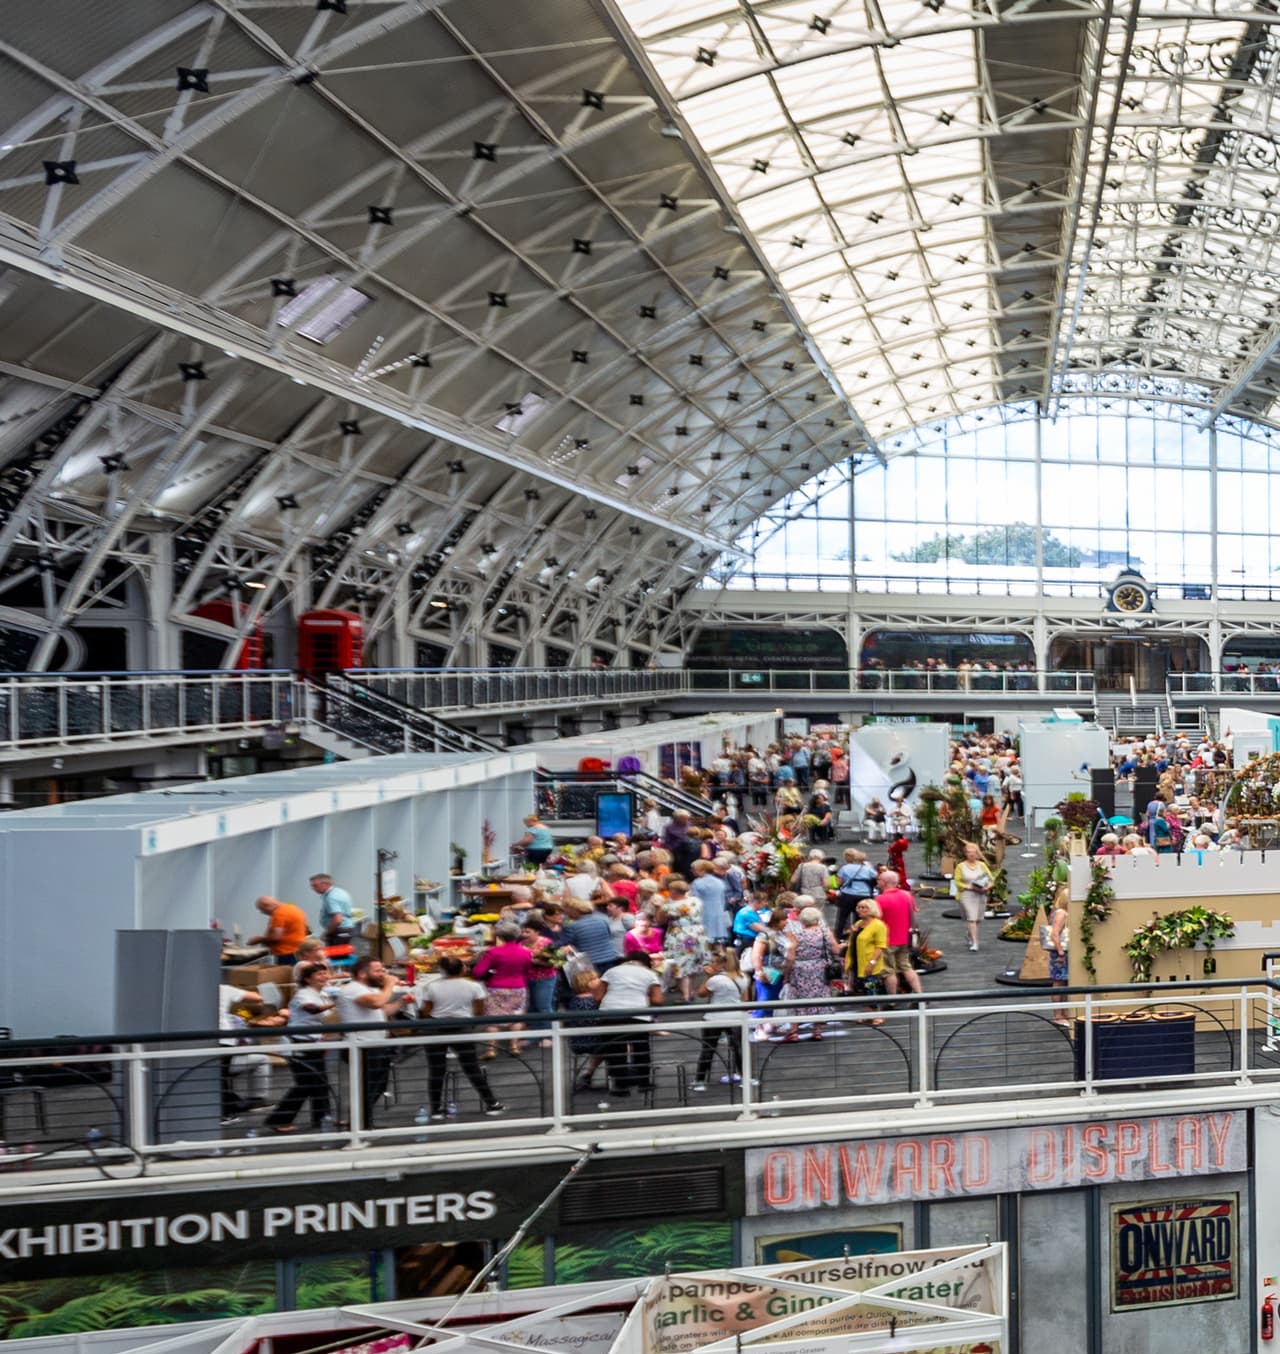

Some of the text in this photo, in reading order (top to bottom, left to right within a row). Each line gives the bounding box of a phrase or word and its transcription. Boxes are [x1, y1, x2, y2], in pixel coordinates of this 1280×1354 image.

[764, 1112, 1234, 1205] ONWARD DISPLAY
[263, 1190, 497, 1238] PRINTERS
[1119, 1216, 1232, 1274] ONWARD
[736, 1302, 755, 1322] &
[526, 1328, 616, 1348] Massagical
